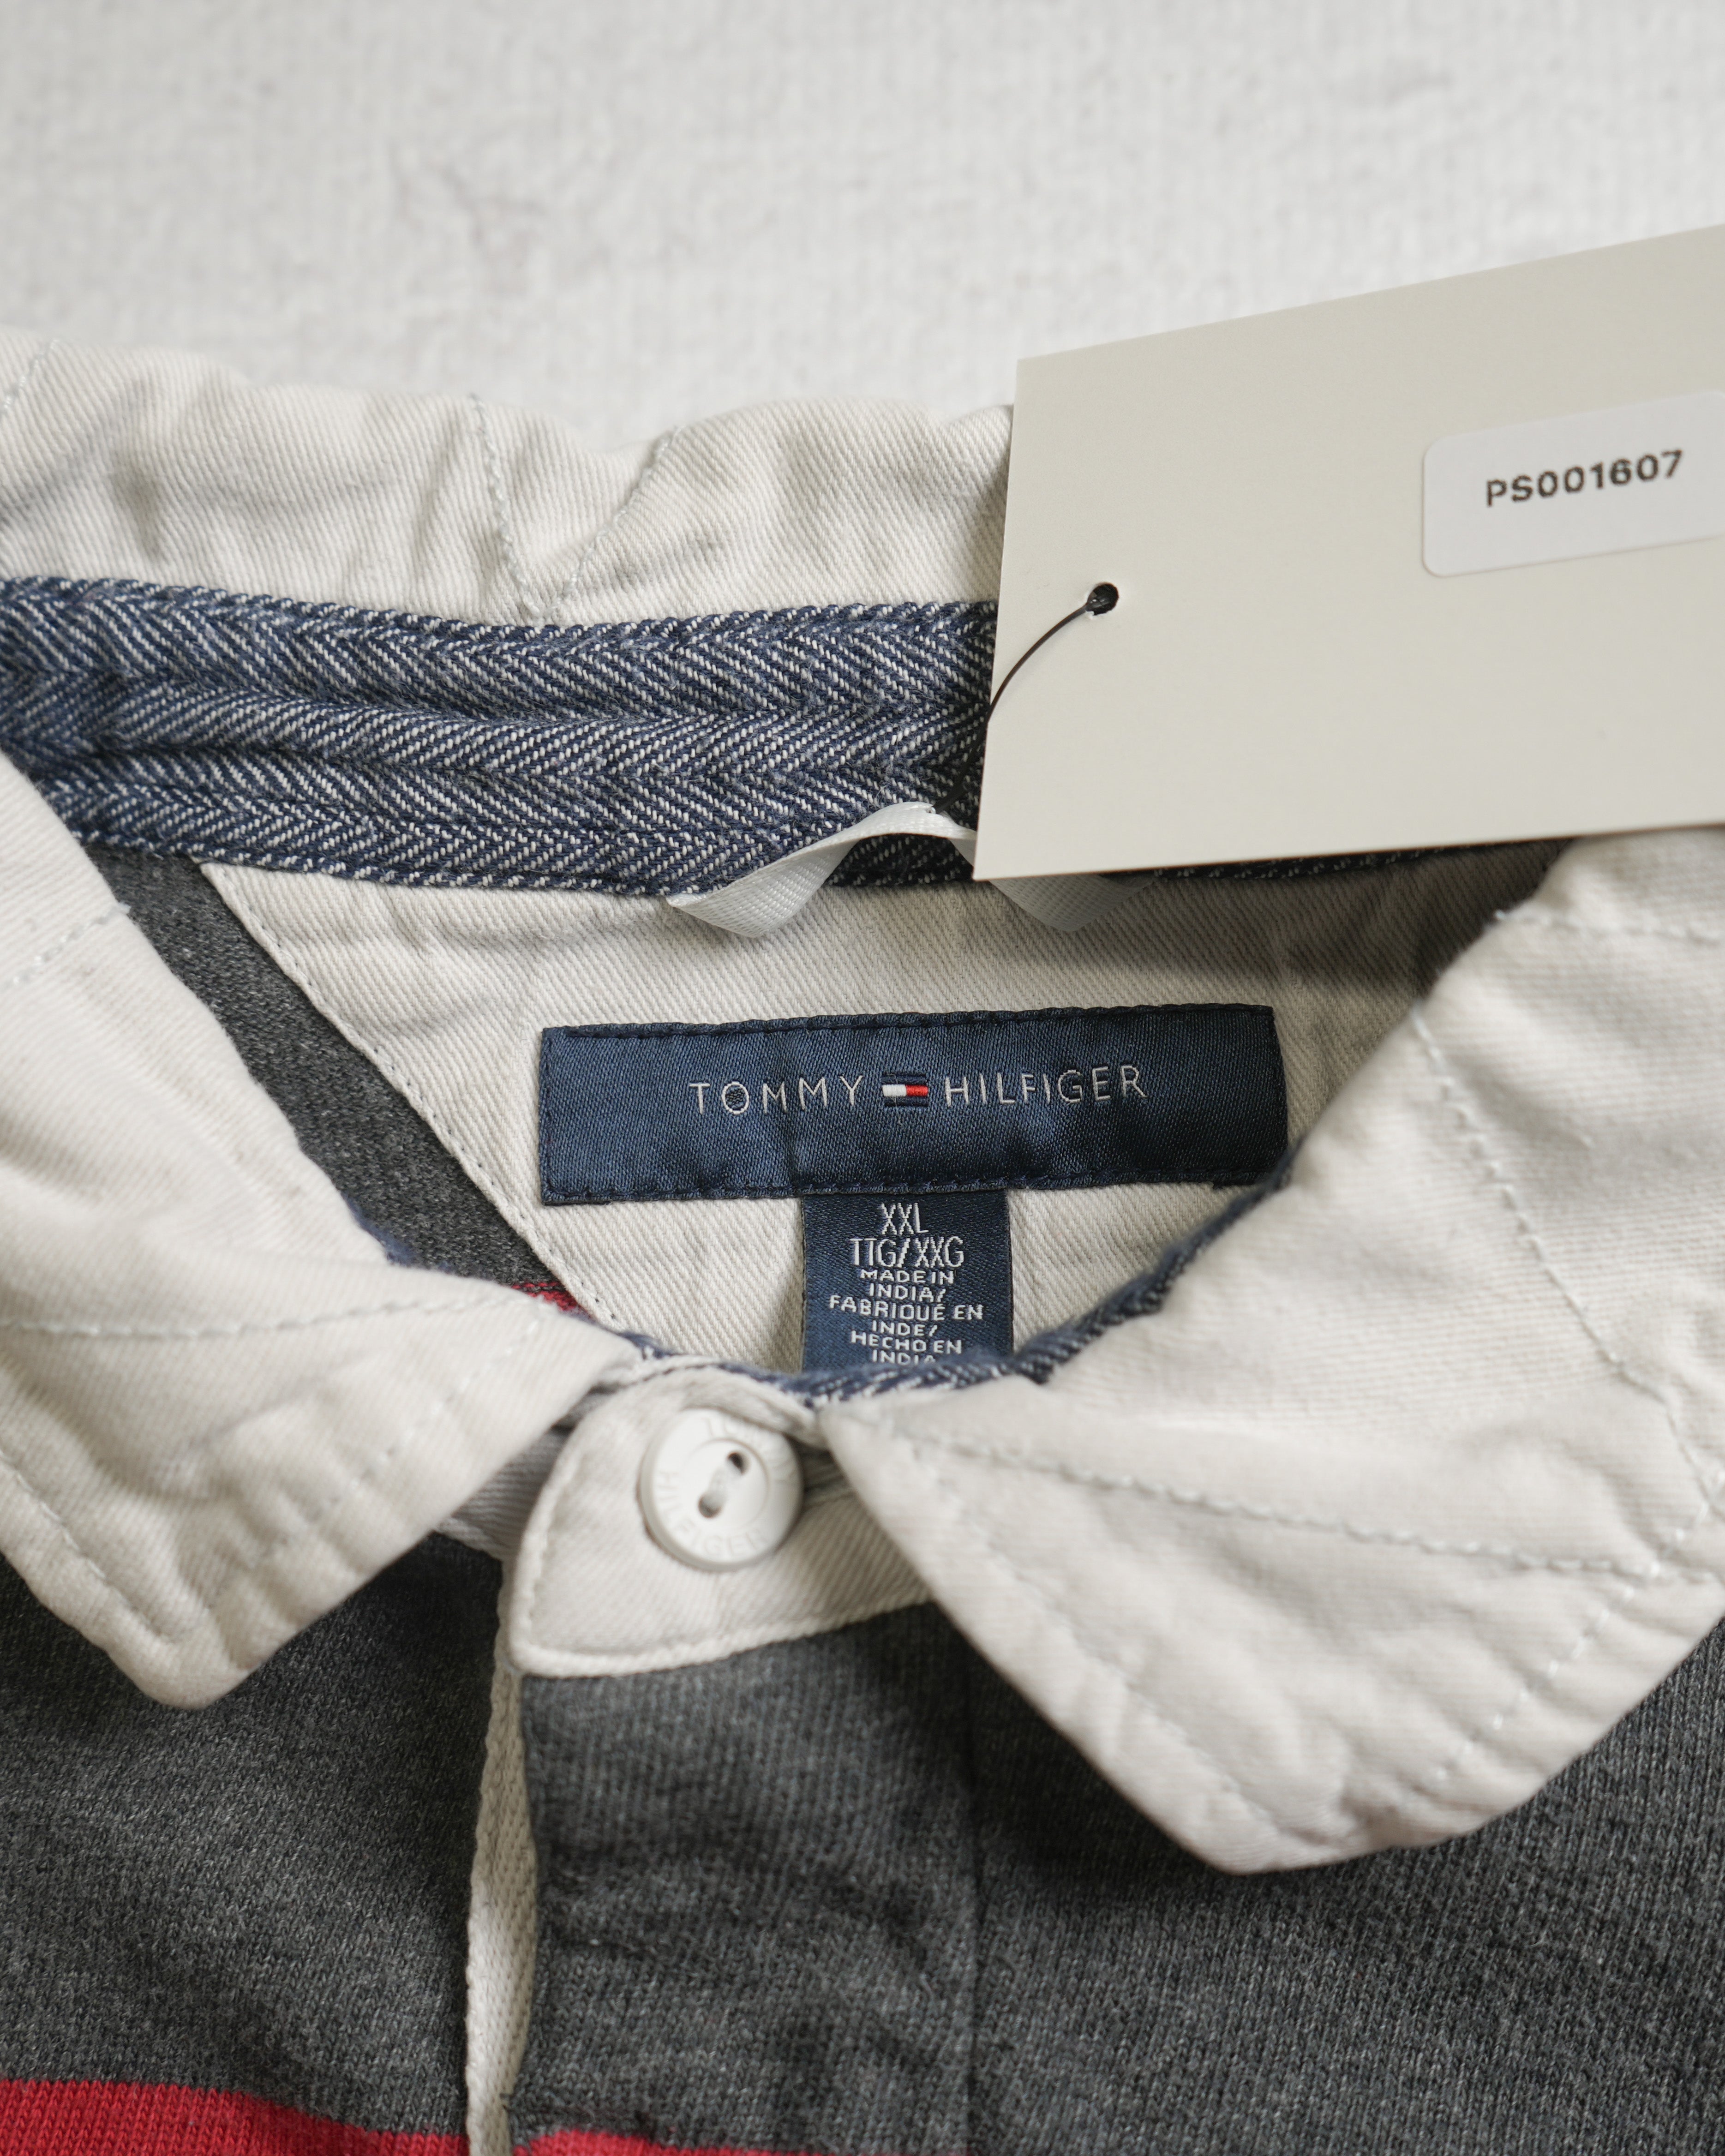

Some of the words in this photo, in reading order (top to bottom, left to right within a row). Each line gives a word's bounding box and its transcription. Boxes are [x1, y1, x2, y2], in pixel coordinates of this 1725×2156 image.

[1486, 449, 1683, 508] PS001607
[689, 1075, 864, 1115] TOMMY
[945, 1064, 1148, 1107] HILFIGER
[880, 1202, 929, 1235] XXL
[849, 1235, 964, 1268] TTG/XXG
[860, 1269, 926, 1283] MADE
[931, 1270, 954, 1285] IN
[869, 1282, 946, 1303] INDIA/
[953, 1304, 984, 1321] EN
[872, 1320, 938, 1337] INDE/
[851, 1330, 927, 1353] HECHO
[933, 1339, 962, 1354] EN
